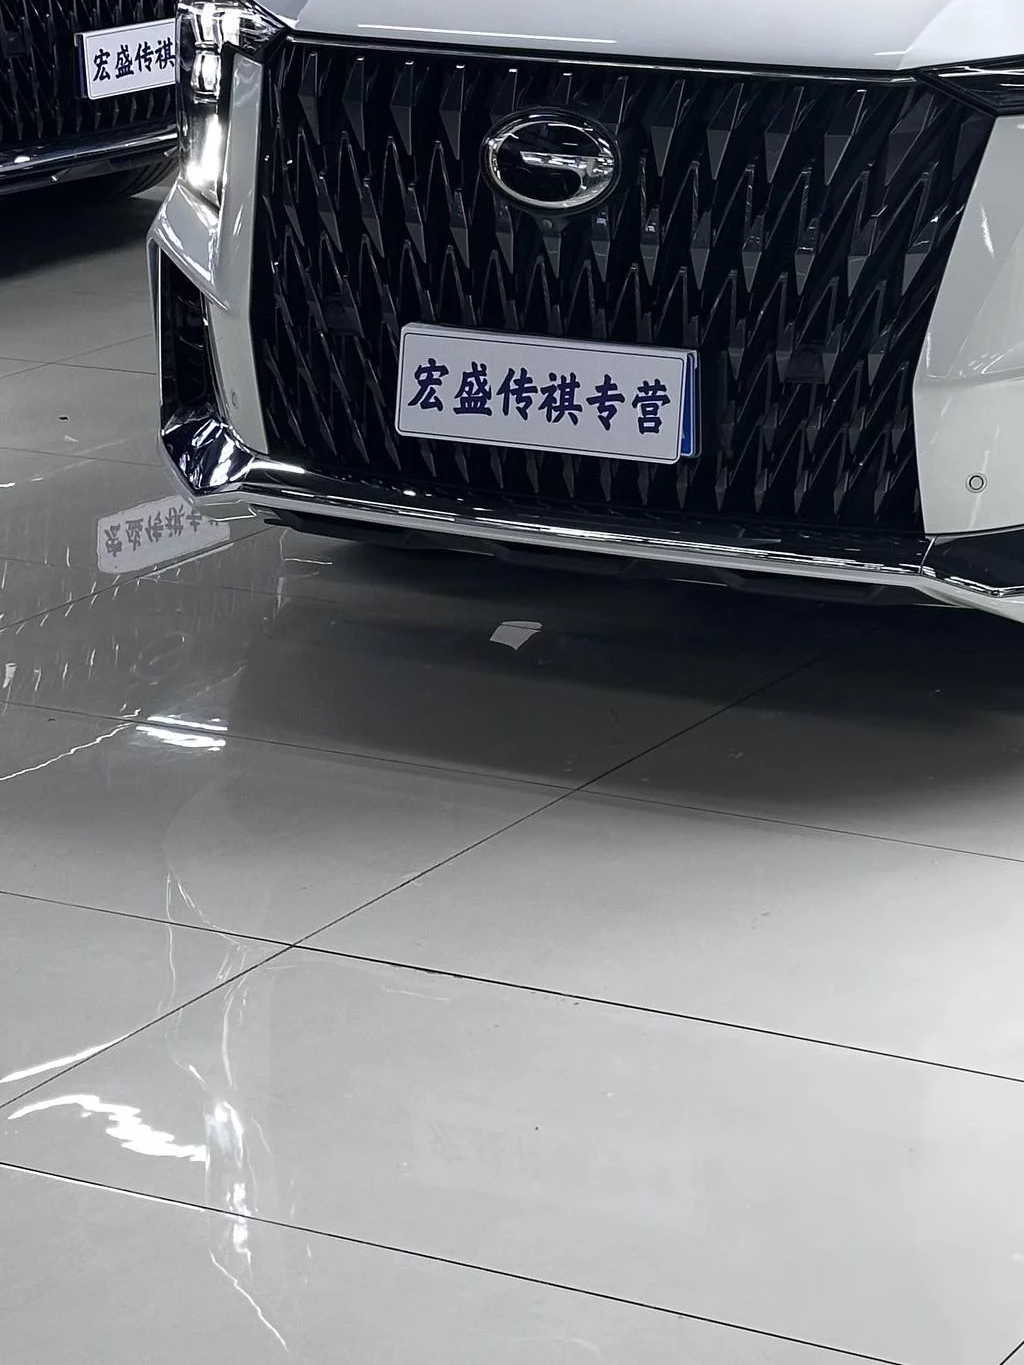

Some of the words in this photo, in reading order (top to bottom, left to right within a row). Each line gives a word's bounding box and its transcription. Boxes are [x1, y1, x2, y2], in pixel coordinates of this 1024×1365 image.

[93, 36, 176, 82] 宏盛传祺
[407, 357, 672, 435] 宏盛传祺专营
